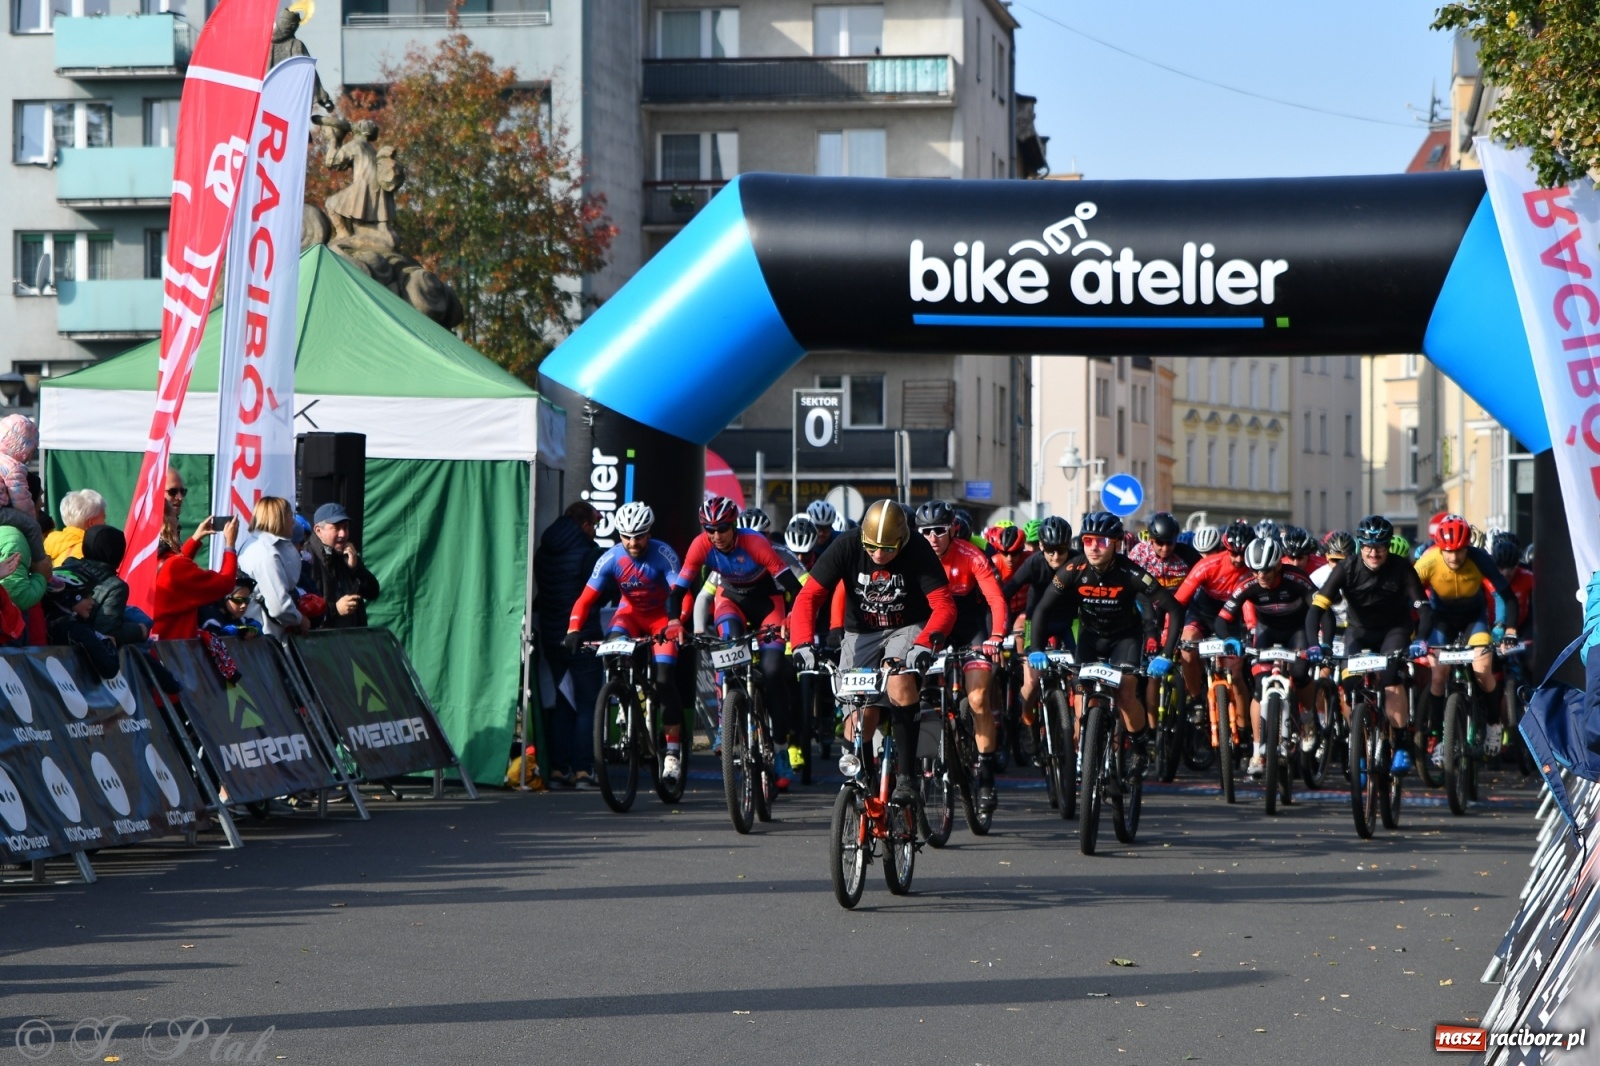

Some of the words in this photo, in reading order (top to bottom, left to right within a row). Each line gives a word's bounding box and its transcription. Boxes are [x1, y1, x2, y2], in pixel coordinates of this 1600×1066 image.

[910, 239, 1049, 303] bike
[1070, 240, 1289, 305] atelier
[230, 111, 288, 524] RACIBÓRZ
[800, 396, 838, 406] SEKTOR
[804, 407, 833, 447] 0
[1078, 585, 1123, 598] CST
[719, 650, 745, 664] 1120
[1355, 658, 1379, 667] 2635
[1088, 668, 1114, 678] 1407
[843, 676, 875, 686] 1184
[347, 716, 429, 751] MERIDA
[219, 734, 312, 772] MERDA
